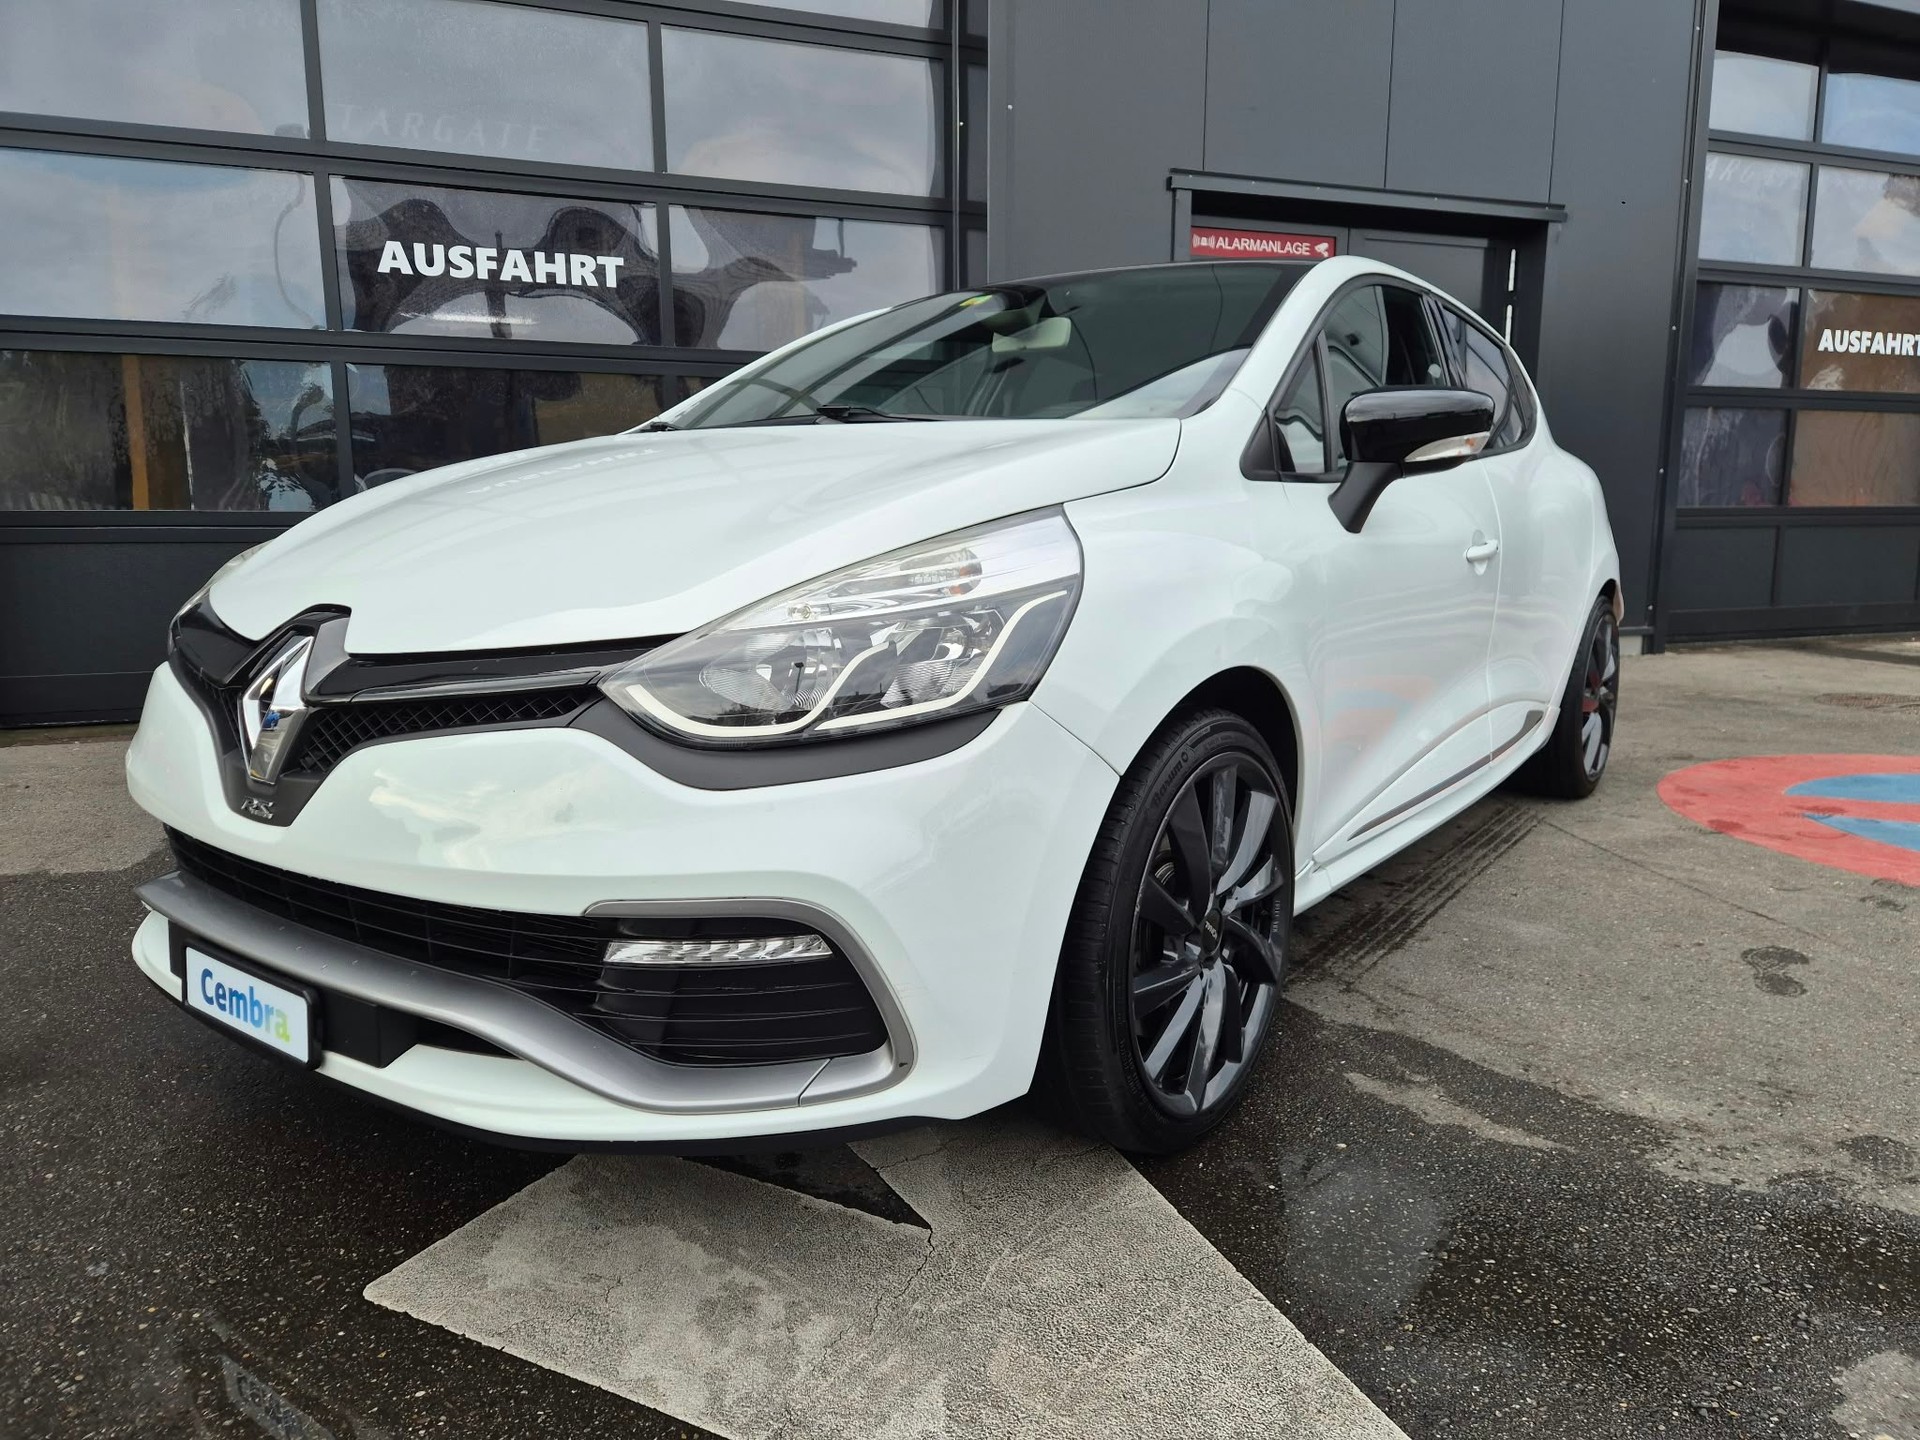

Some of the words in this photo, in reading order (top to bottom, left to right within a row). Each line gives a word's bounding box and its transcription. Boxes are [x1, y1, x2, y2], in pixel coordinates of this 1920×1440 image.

[377, 240, 624, 288] AUSFAHRT
[1216, 236, 1311, 256] ALARMANLAGE
[201, 967, 291, 1043] Cembra
